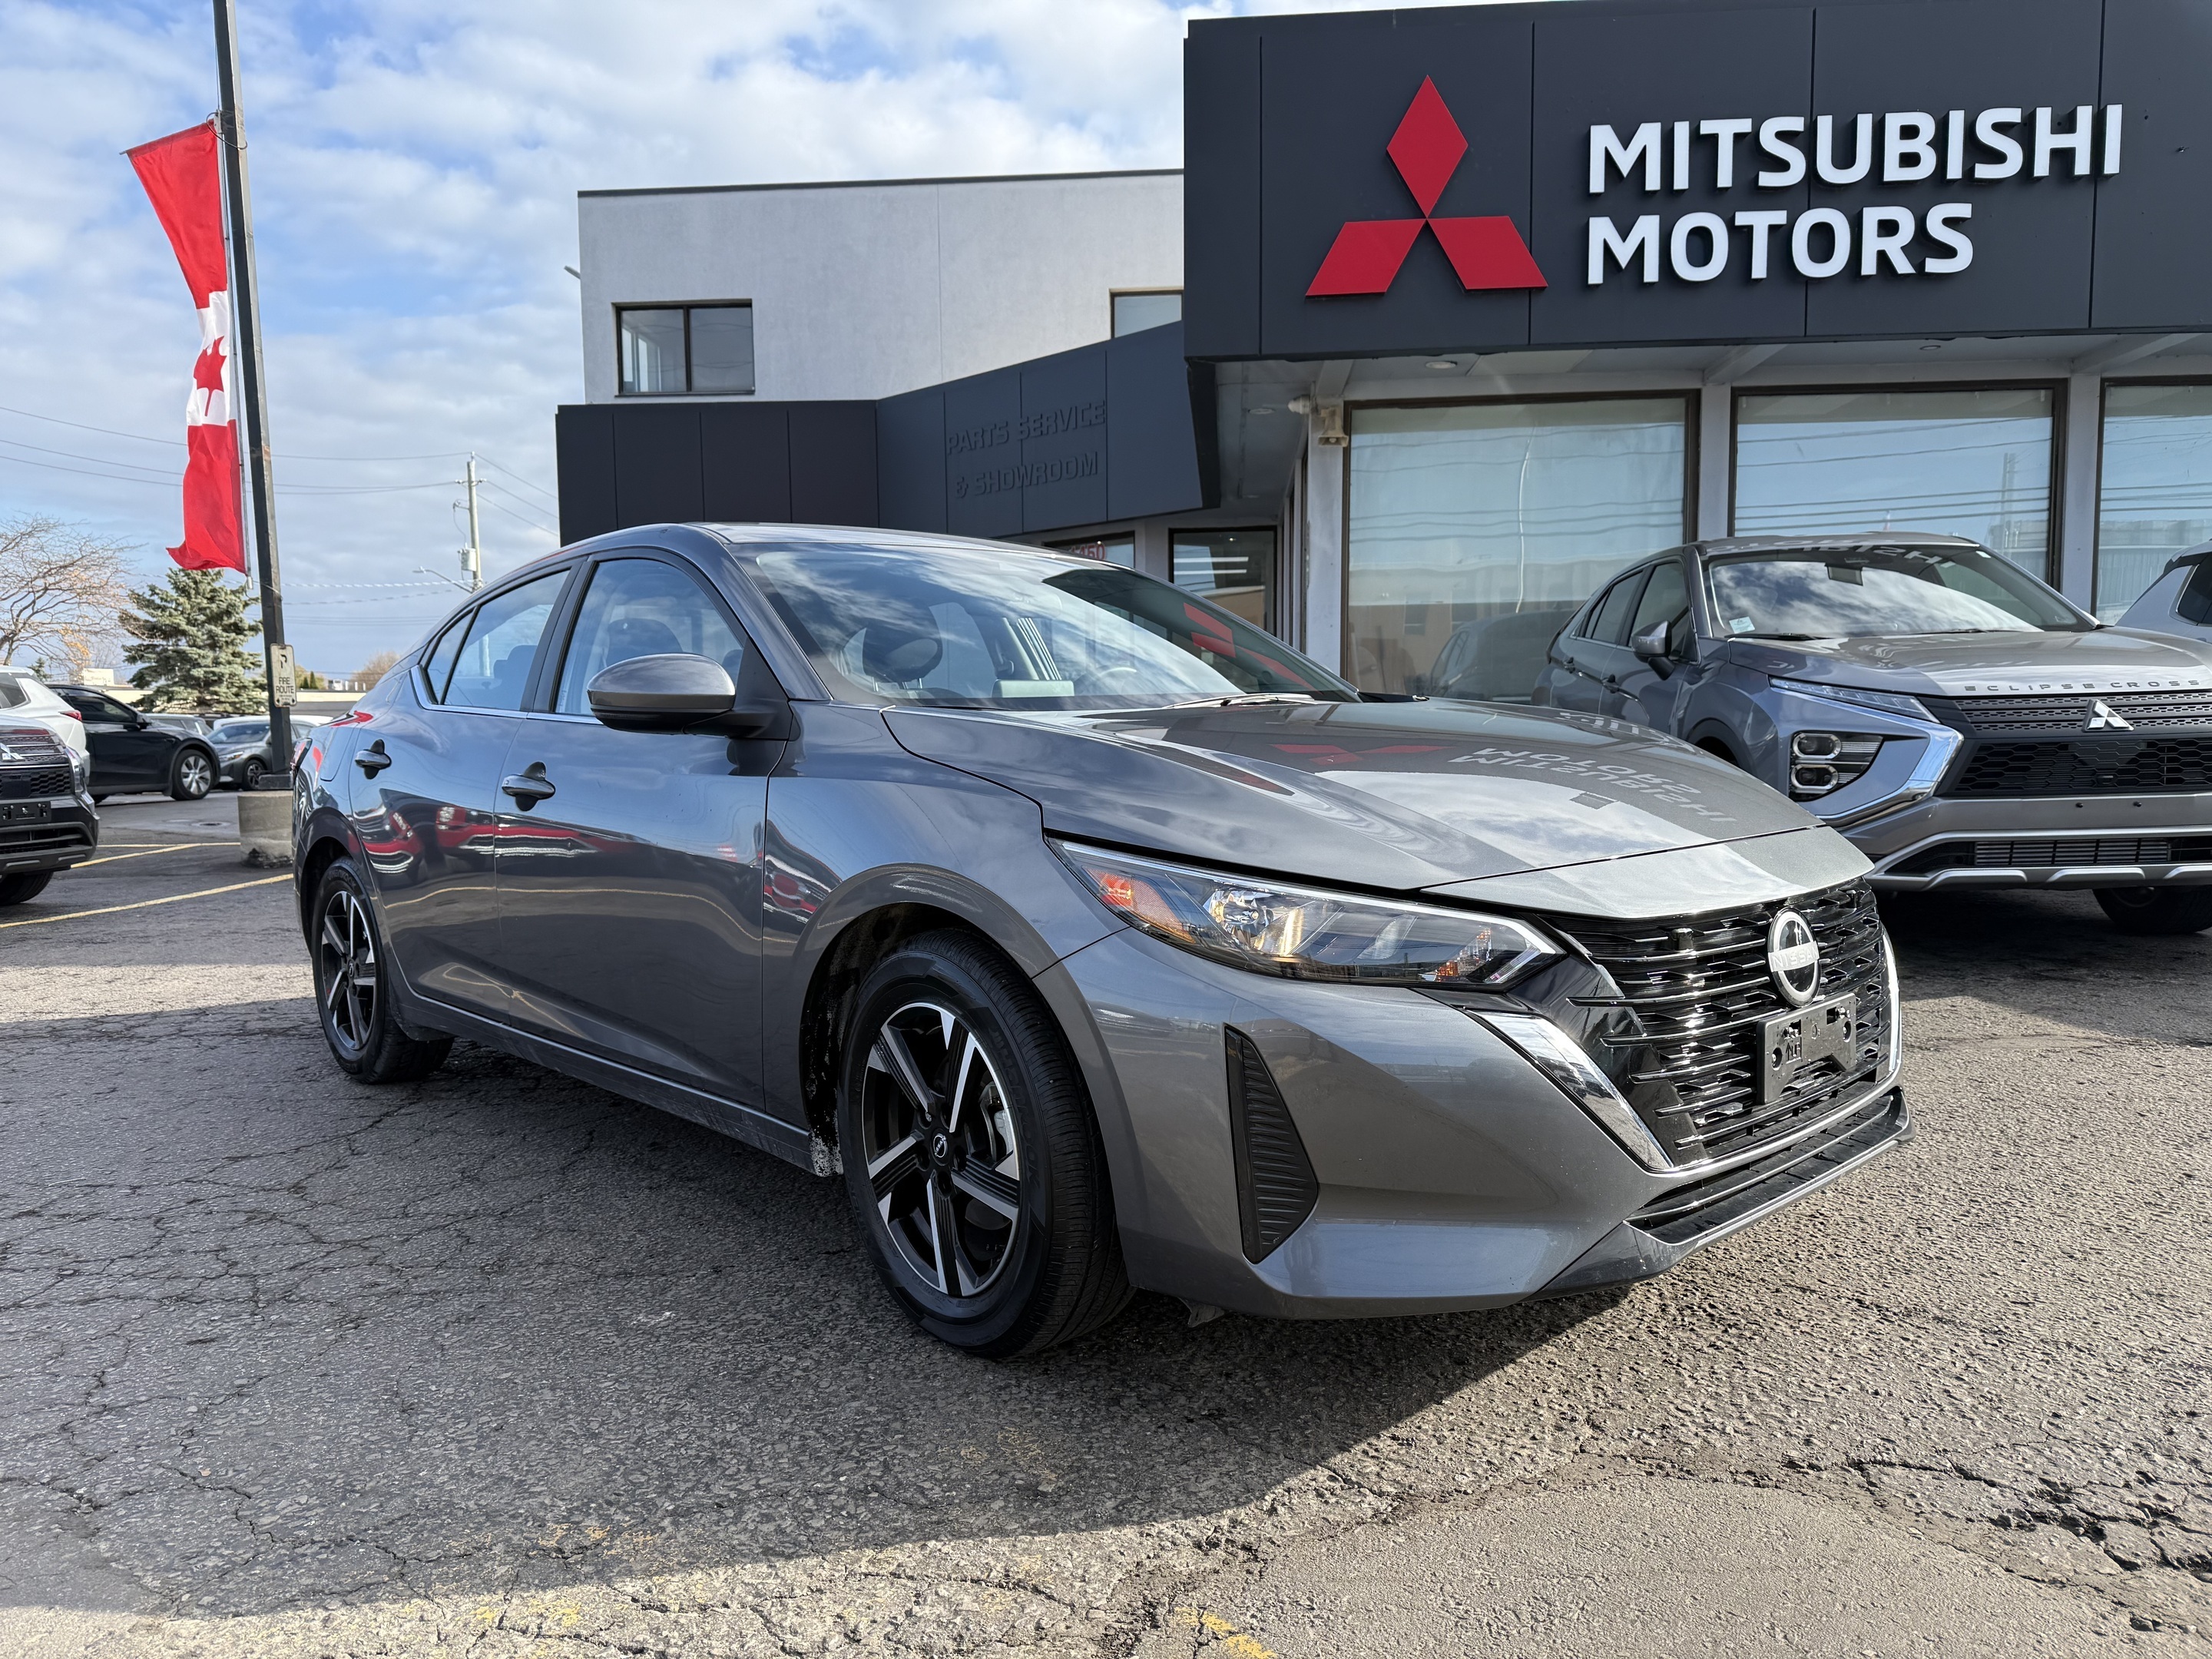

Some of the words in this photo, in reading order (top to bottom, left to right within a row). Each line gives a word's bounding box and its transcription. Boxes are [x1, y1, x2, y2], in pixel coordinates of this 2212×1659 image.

[1588, 104, 2123, 194] MITSUBISHI
[1587, 203, 1974, 285] MOTORS
[947, 420, 1009, 456] PARTS
[1016, 399, 1106, 441] SERVICE
[955, 475, 969, 499] &
[974, 451, 1098, 496] SHOWROOM
[275, 685, 295, 694] ROUTE
[278, 677, 290, 685] FIRE
[1964, 683, 2096, 692] ECLIPSE
[2110, 680, 2200, 689] CROSS
[1770, 944, 1818, 969] NISSAN
